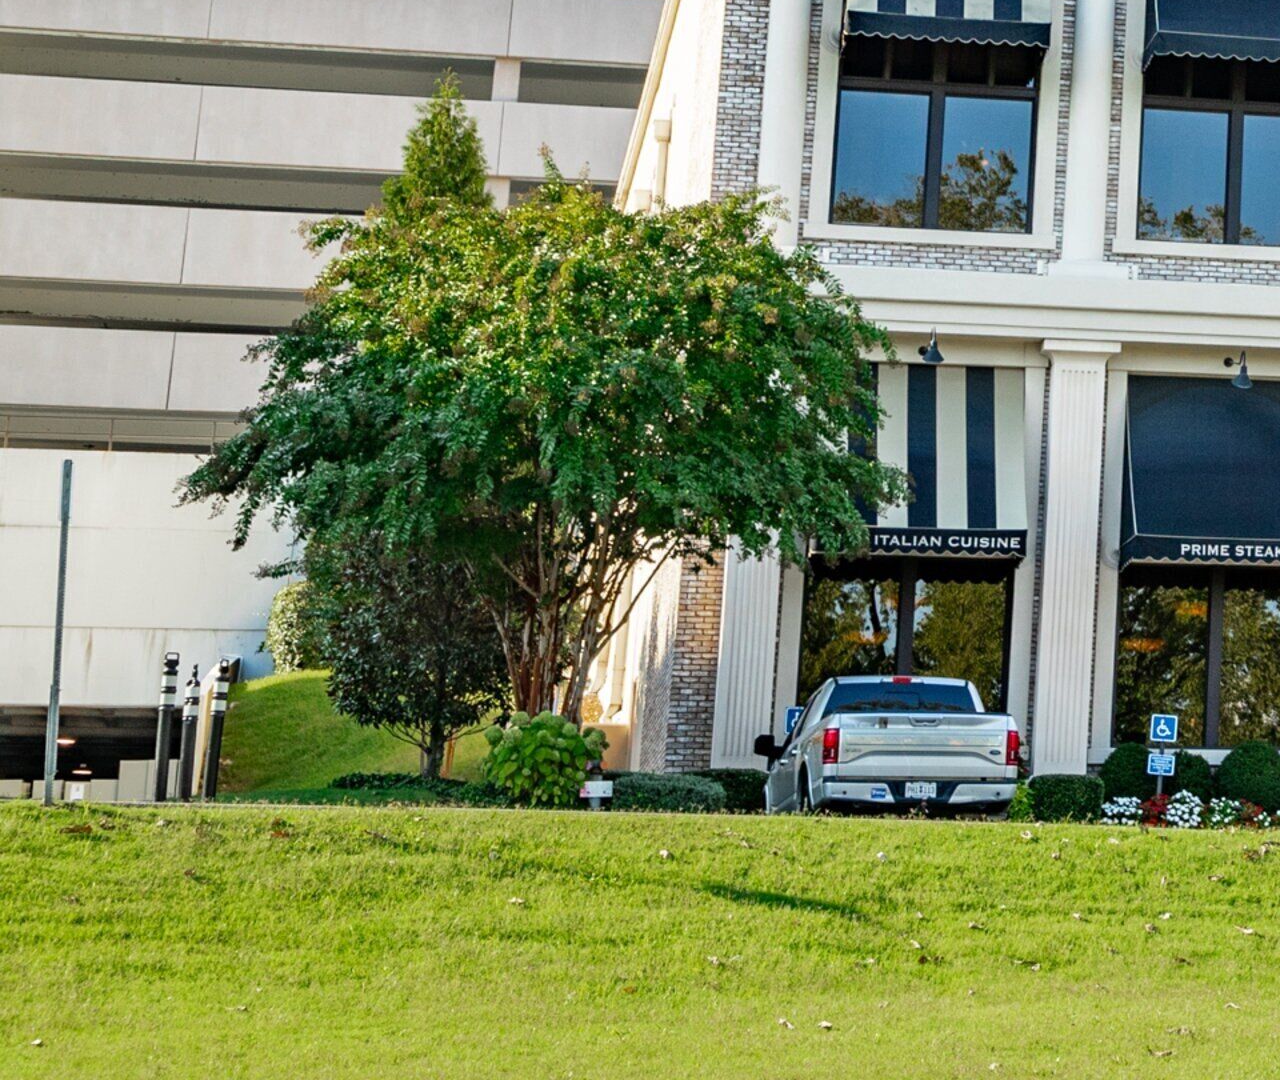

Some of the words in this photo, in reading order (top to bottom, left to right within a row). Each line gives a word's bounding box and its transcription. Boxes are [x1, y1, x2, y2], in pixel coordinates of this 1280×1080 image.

[874, 534, 942, 547] ITALIAN
[947, 535, 1021, 549] CUISINE
[1180, 543, 1230, 556] PRIME
